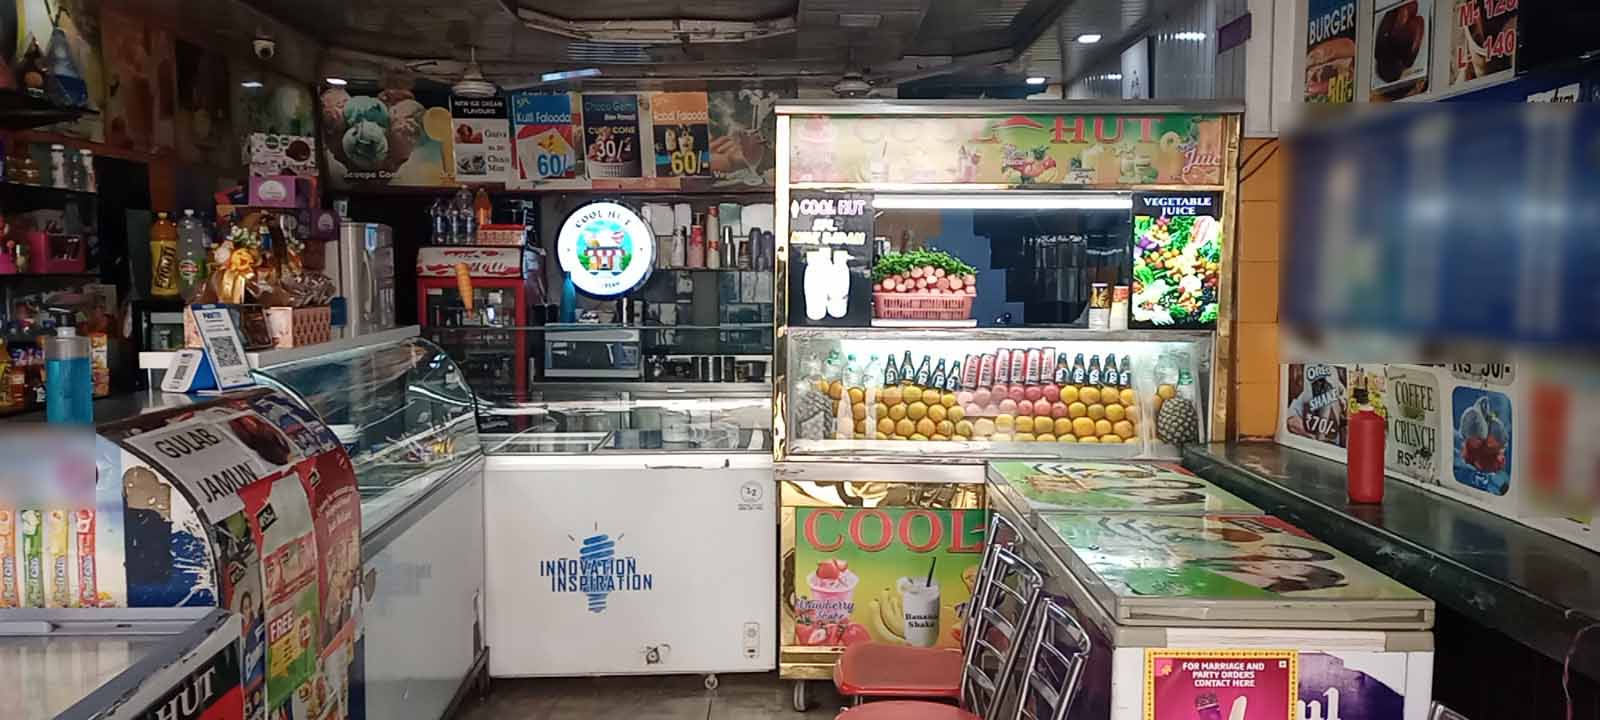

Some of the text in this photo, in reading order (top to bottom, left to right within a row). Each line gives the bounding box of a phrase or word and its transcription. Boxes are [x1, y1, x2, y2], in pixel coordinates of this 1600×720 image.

[1308, 2, 1356, 45] BURGER
[1484, 28, 1516, 61] 140
[536, 112, 570, 122] Falooda
[1049, 117, 1165, 144] HUT
[672, 150, 709, 174] 60/-
[800, 199, 836, 215] COOL
[1143, 197, 1212, 206] VEGETABLE
[576, 210, 604, 228] COOL
[1162, 206, 1196, 216] JUICE
[1309, 390, 1339, 411] SHAKE
[1395, 380, 1434, 412] COFFEE
[154, 428, 221, 458] GULAB
[1394, 418, 1435, 452] CRUNCH
[196, 461, 258, 503] JAMUN
[804, 508, 986, 554] COOL
[540, 559, 636, 577] INNOVATION
[552, 574, 652, 592] INSPIRATION
[270, 609, 294, 638] FREE
[905, 613, 937, 621] Banana
[908, 621, 934, 629] Shake
[1182, 662, 1265, 671] FOR MARRIAGE AND
[1192, 671, 1255, 679] PARTY ORDERS
[1194, 679, 1255, 688] CONTACT HERE
